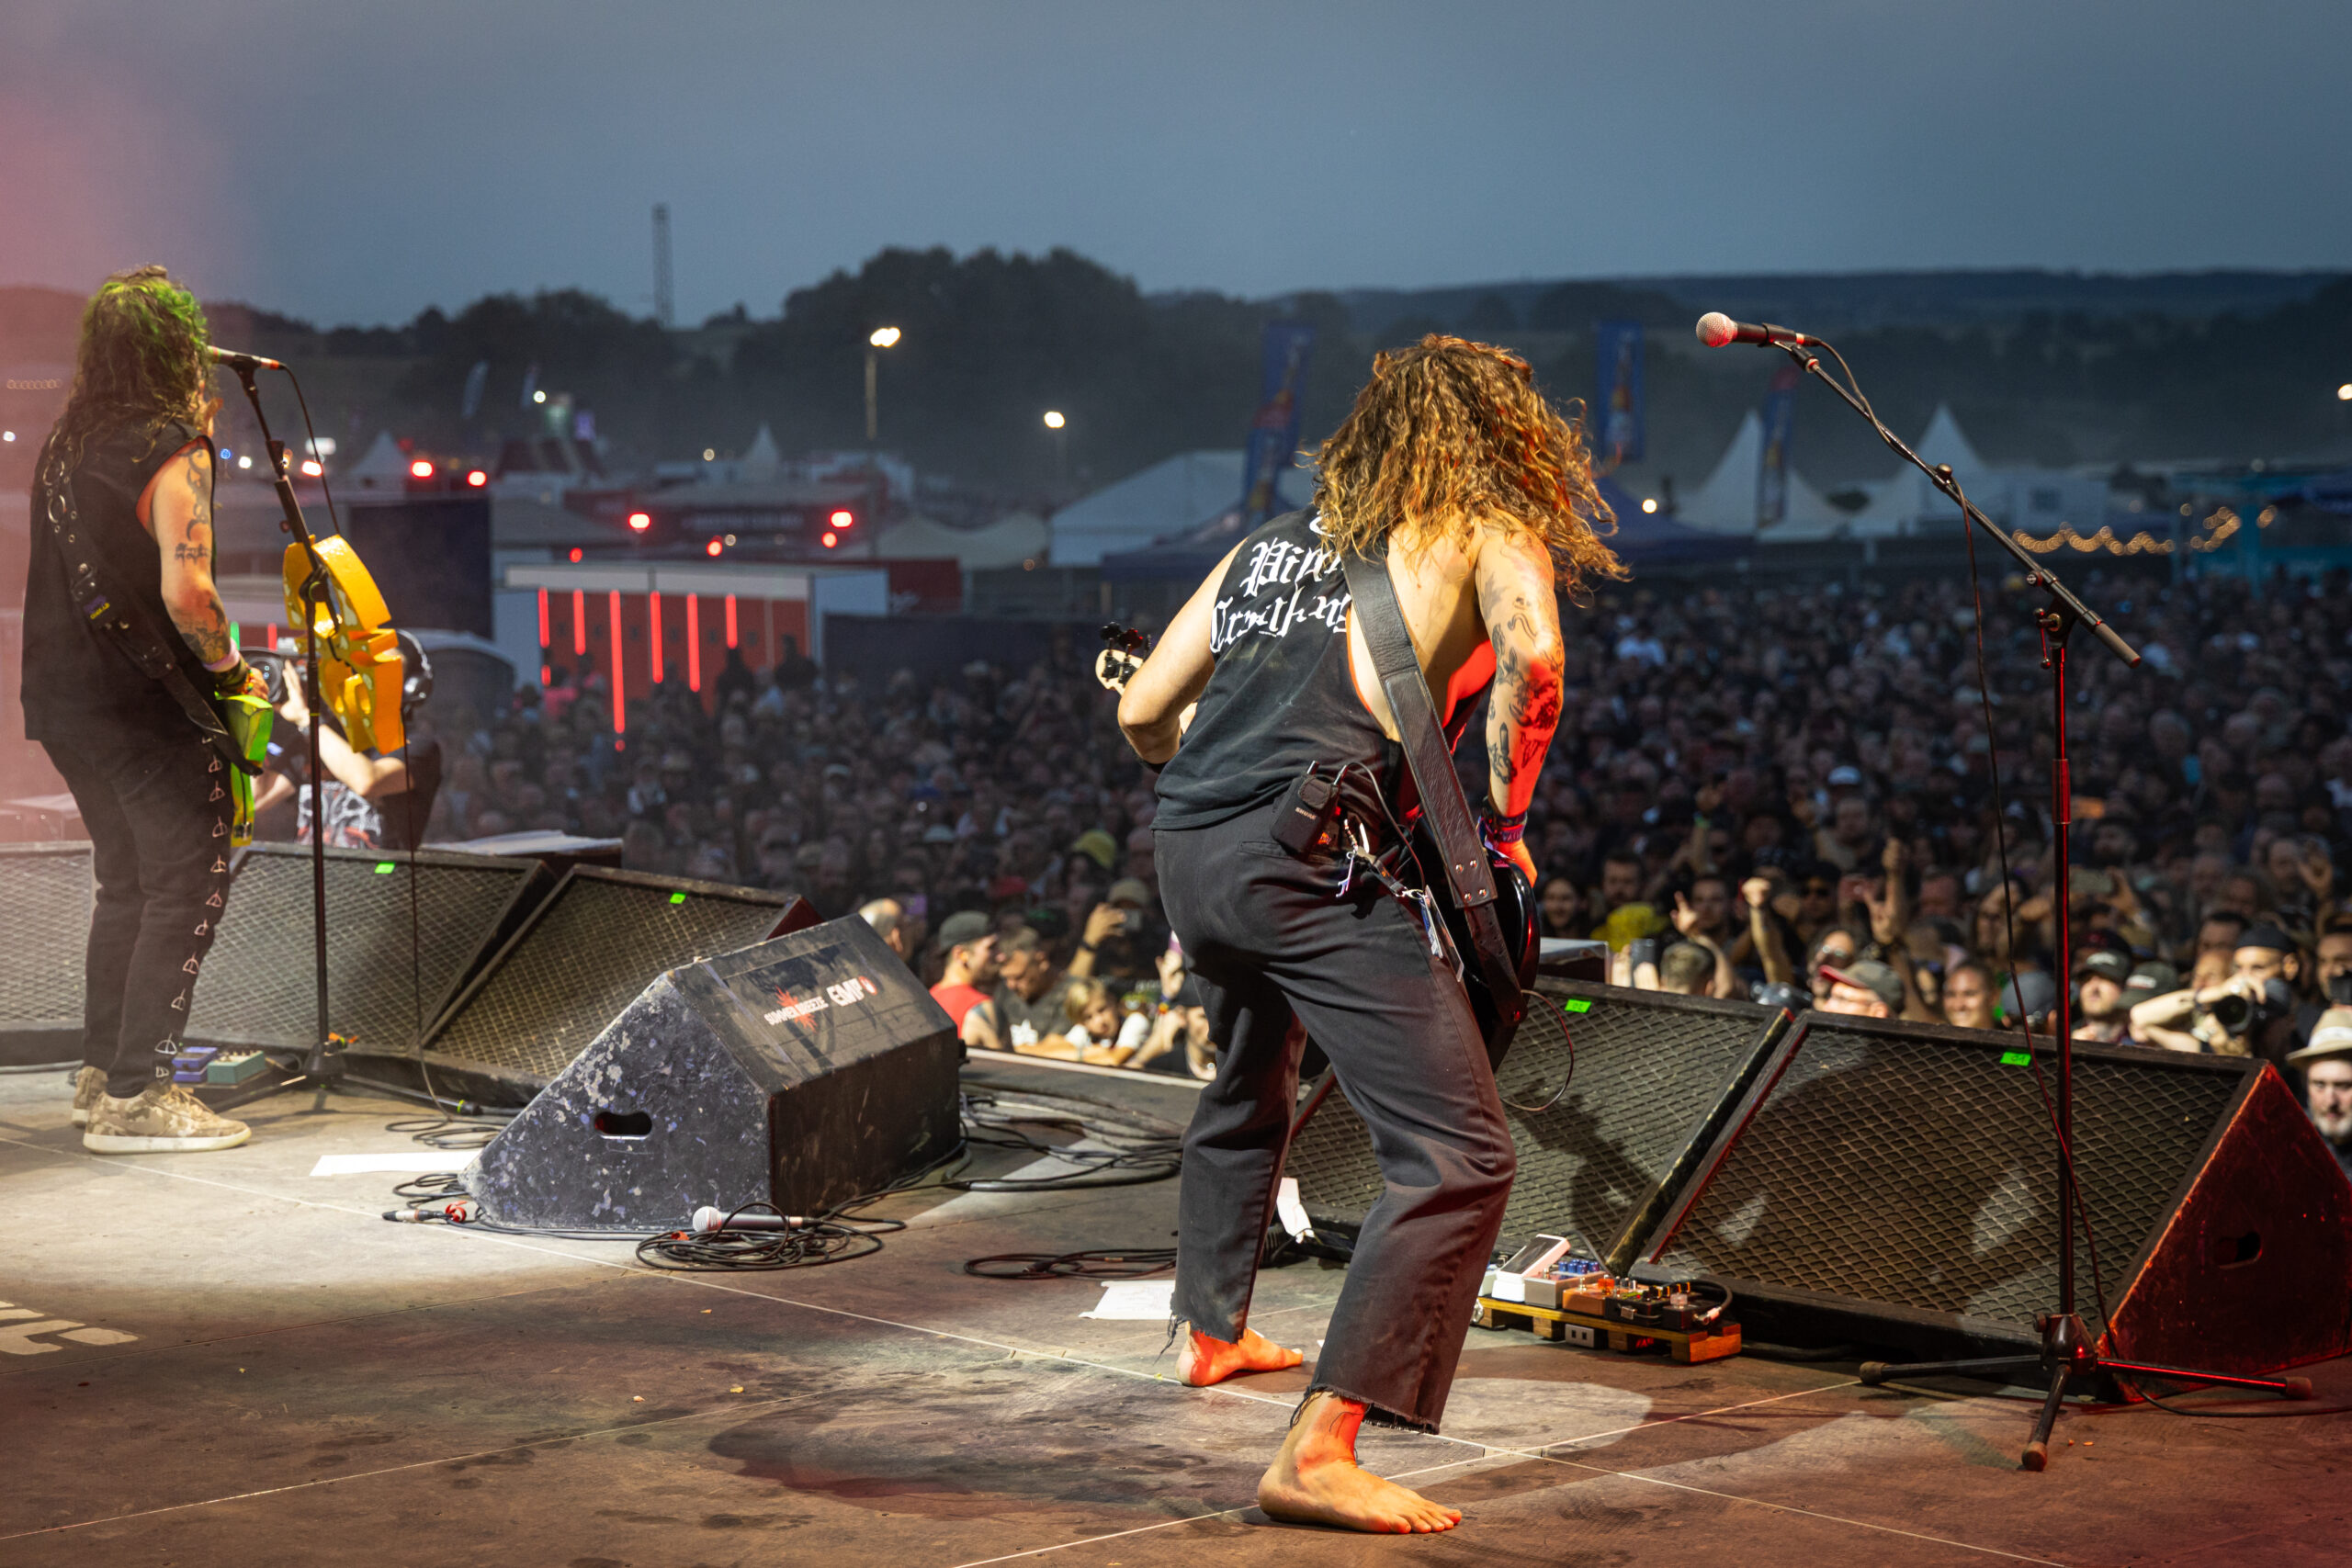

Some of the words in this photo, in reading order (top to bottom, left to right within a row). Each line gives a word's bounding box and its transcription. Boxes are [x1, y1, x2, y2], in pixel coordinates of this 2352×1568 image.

[1295, 807, 1317, 820] SHURE
[826, 977, 865, 1007] EMP
[764, 1005, 797, 1025] SUMMER
[797, 996, 829, 1015] BREEZE
